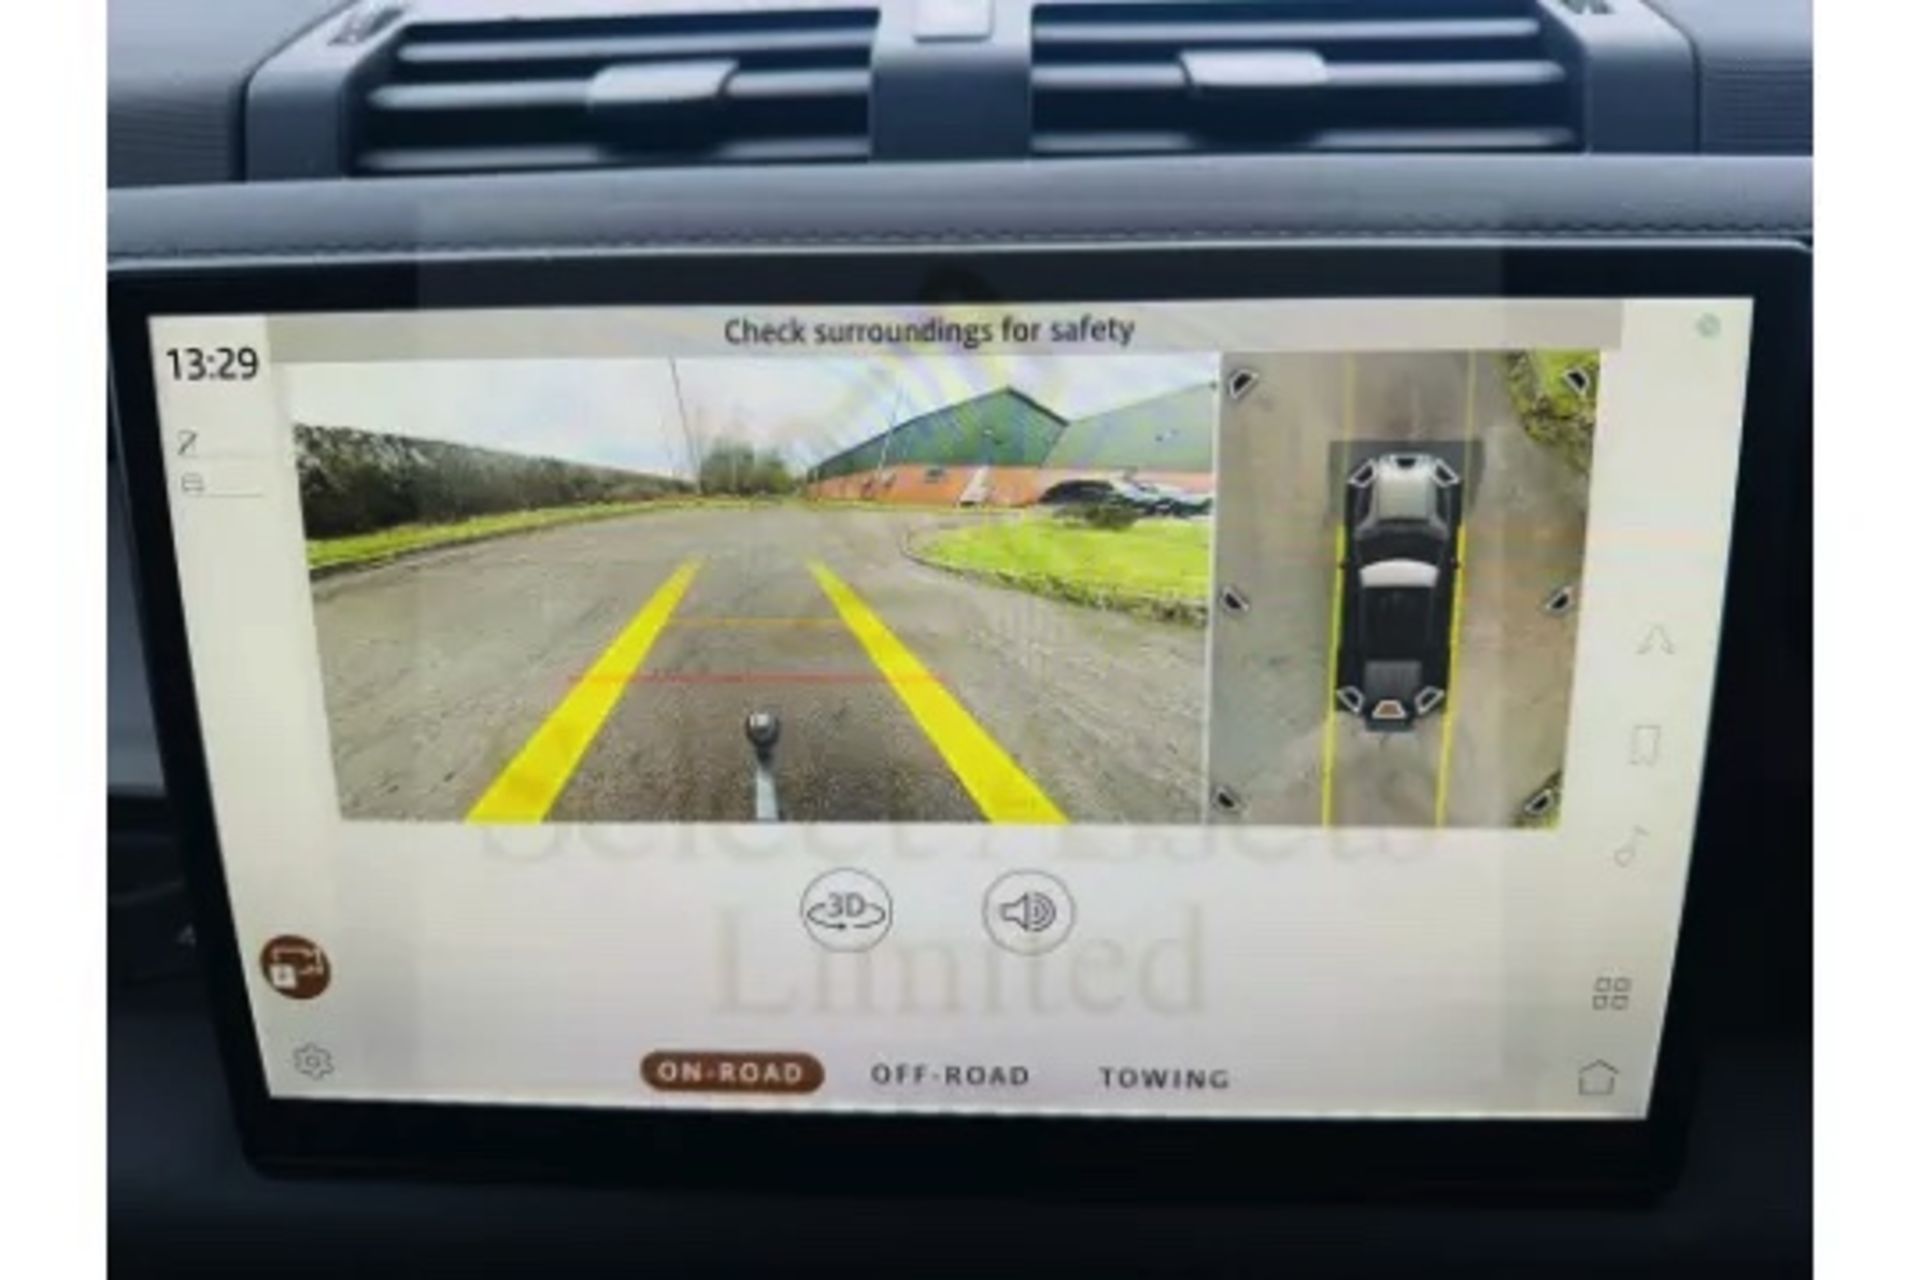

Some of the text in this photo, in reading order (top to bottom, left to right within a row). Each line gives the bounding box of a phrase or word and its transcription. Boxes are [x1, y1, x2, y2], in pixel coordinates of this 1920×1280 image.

[724, 314, 1136, 350] Check surroundings for safety
[166, 346, 260, 381] 13:29
[827, 891, 866, 918] 3D
[656, 1061, 804, 1087] ON-ROAD
[870, 1063, 1030, 1088] OFF-ROAD
[1098, 1066, 1230, 1091] TOWING
